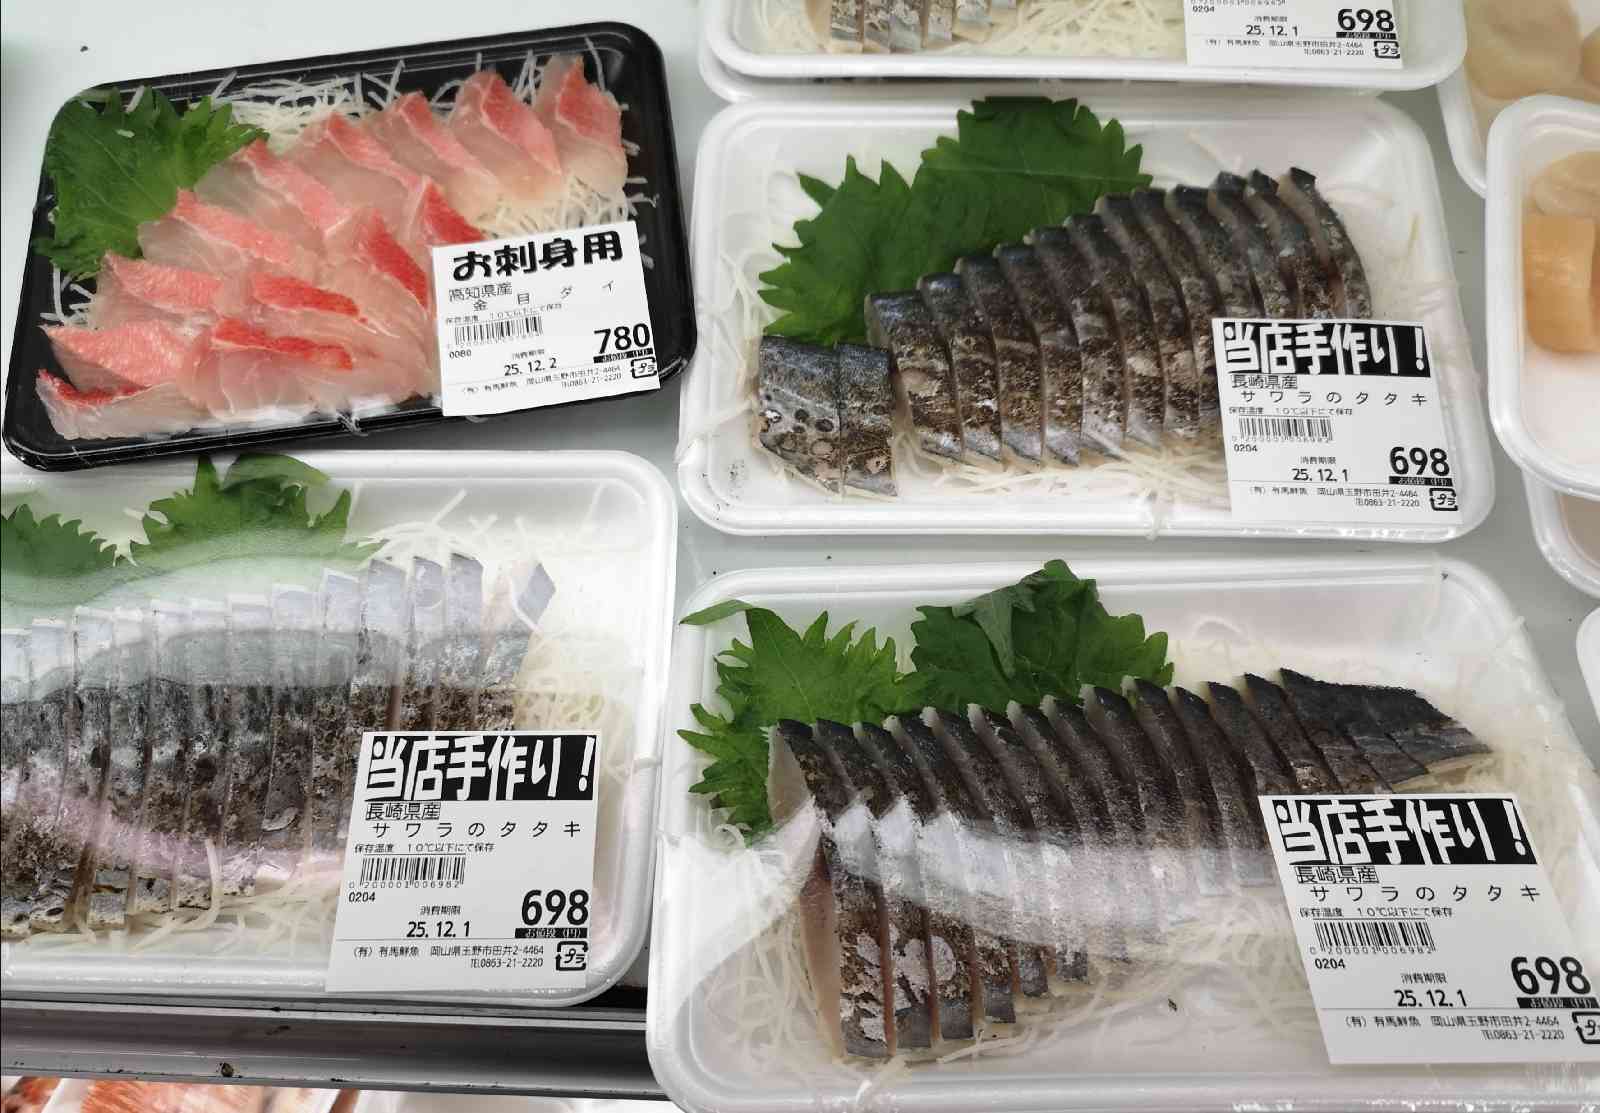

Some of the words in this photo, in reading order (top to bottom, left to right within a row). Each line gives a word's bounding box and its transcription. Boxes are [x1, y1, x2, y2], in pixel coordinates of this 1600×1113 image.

[1337, 8, 1394, 32] 698
[453, 230, 623, 281] お刺身用
[449, 281, 513, 301] 高知県産
[594, 323, 650, 354] 780
[1232, 375, 1298, 389] 長崎県産
[1241, 391, 1427, 406] サワラのタタキ
[1390, 446, 1450, 476] 698
[365, 802, 440, 820] 長崎県産
[373, 821, 581, 838] サワラのタタキ
[1296, 866, 1380, 884] 長崎県産
[348, 892, 376, 902] 0204
[1310, 885, 1540, 902] サワラのタタキ
[420, 905, 461, 915] 消費期限
[521, 889, 589, 926] 698
[406, 921, 471, 938] 25.12.1
[563, 949, 586, 964] プラ
[1315, 958, 1345, 969] 0204
[1401, 973, 1447, 984] 消費期限
[1511, 956, 1591, 995] 698
[1394, 989, 1468, 1007] 25.12.1
